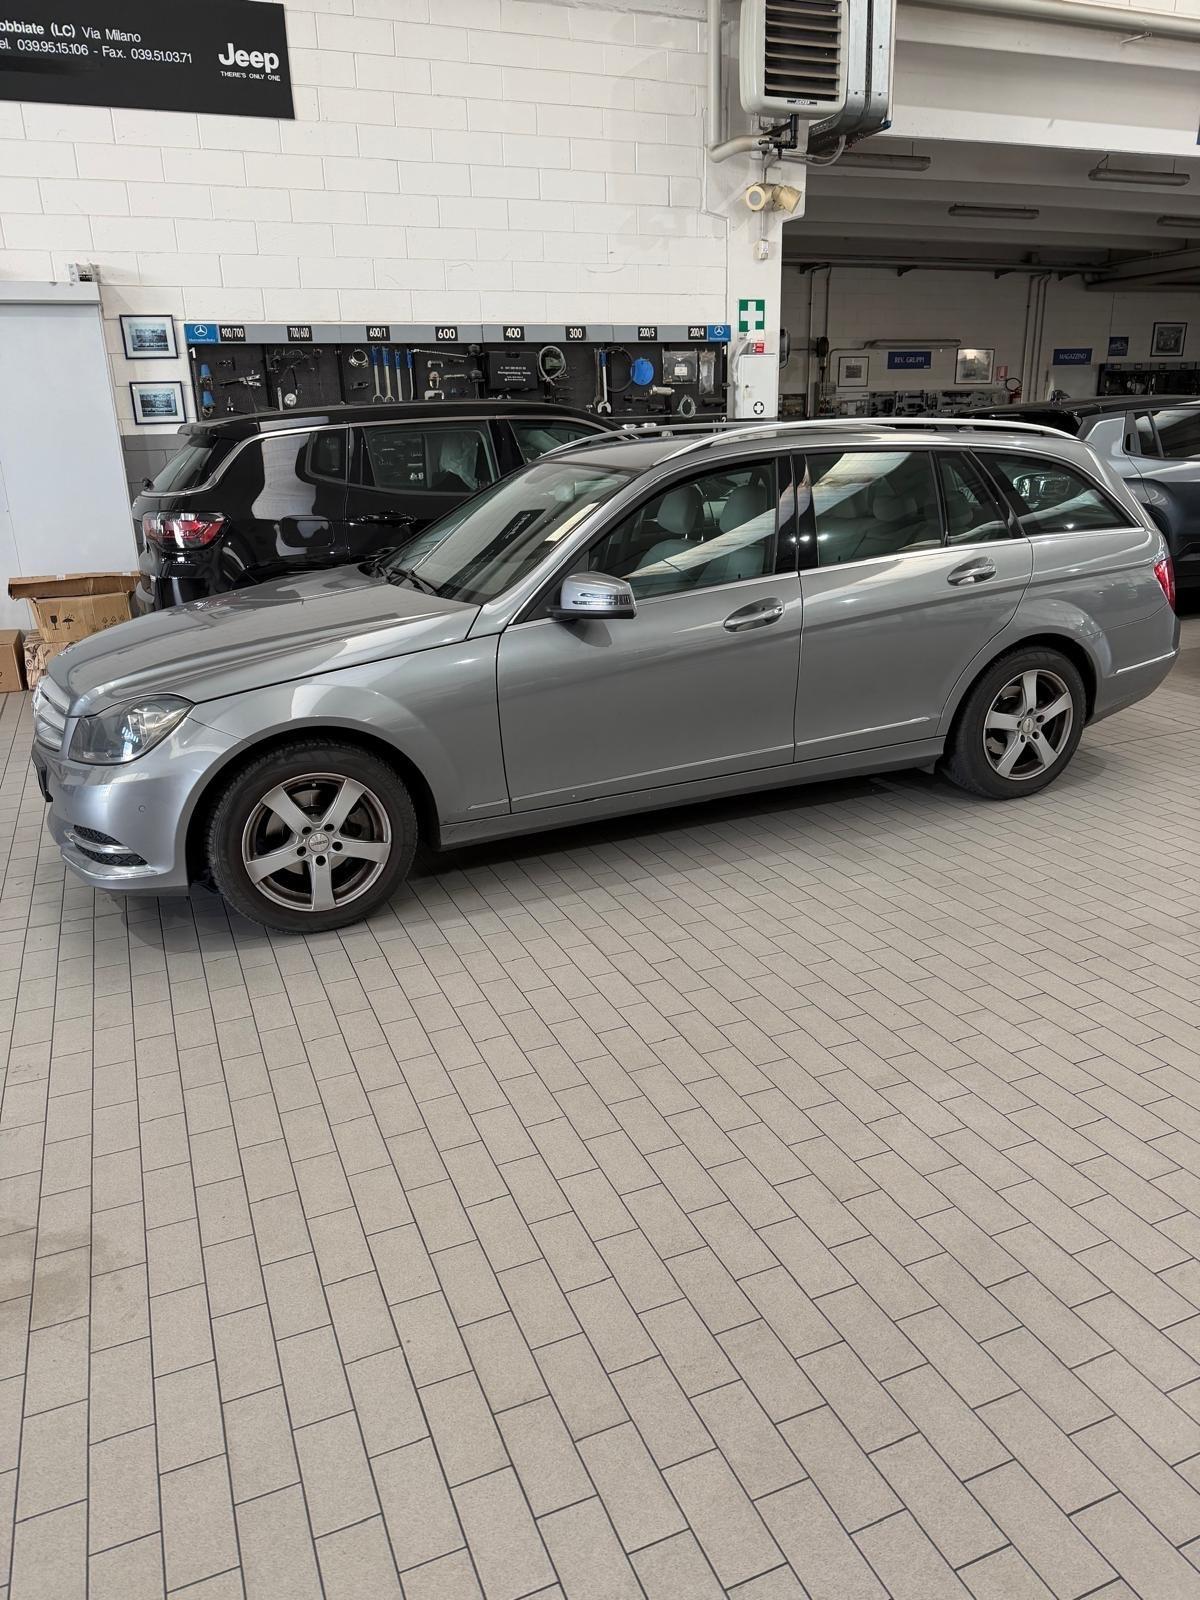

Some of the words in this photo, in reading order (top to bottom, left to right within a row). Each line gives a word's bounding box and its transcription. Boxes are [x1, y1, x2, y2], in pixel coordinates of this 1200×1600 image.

[50, 22, 76, 39] (LC)
[81, 26, 101, 39] Via
[105, 28, 141, 43] Milano
[17, 39, 89, 56] 039.95.15.106
[102, 45, 126, 59] Fax.
[130, 48, 192, 63] 039.51.03.71
[218, 42, 280, 74] Jeep
[220, 70, 247, 79] THERE'S
[267, 74, 281, 82] ONE
[221, 327, 245, 339] 900/700
[289, 327, 310, 339] 700/600
[369, 327, 387, 338] 600/1
[437, 328, 456, 339] 600
[505, 327, 522, 338] 400
[569, 328, 583, 338] 300
[639, 327, 656, 338] 200/5
[689, 327, 705, 338] 200/4
[188, 346, 197, 359] 1
[721, 344, 728, 355] 1
